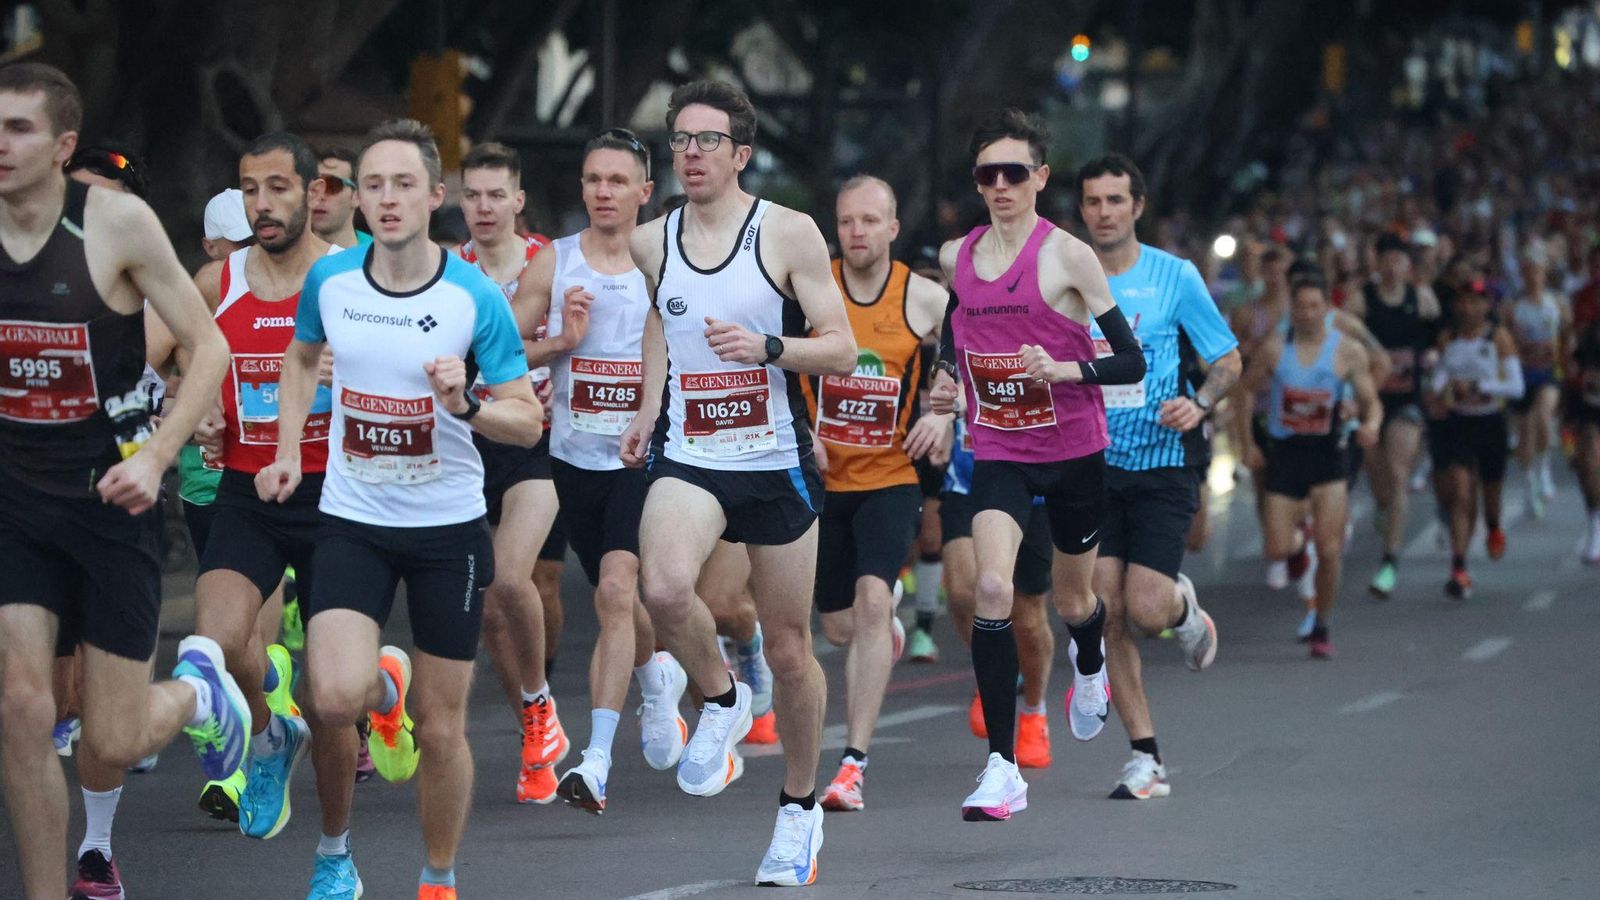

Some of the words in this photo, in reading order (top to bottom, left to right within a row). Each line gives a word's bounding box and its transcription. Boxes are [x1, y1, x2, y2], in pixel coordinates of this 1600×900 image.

[743, 225, 757, 251] soar
[342, 307, 412, 327] Norconsult
[6, 327, 79, 344] GENERALI
[9, 358, 62, 379] 5995
[700, 373, 761, 389] GENERALI
[841, 378, 895, 393] GENERALI
[987, 382, 1025, 396] 5481
[587, 385, 636, 402] 14785
[360, 397, 427, 415] GENERALI
[697, 400, 752, 419] 10629
[837, 399, 878, 416] 4727
[356, 424, 413, 446] 14761
